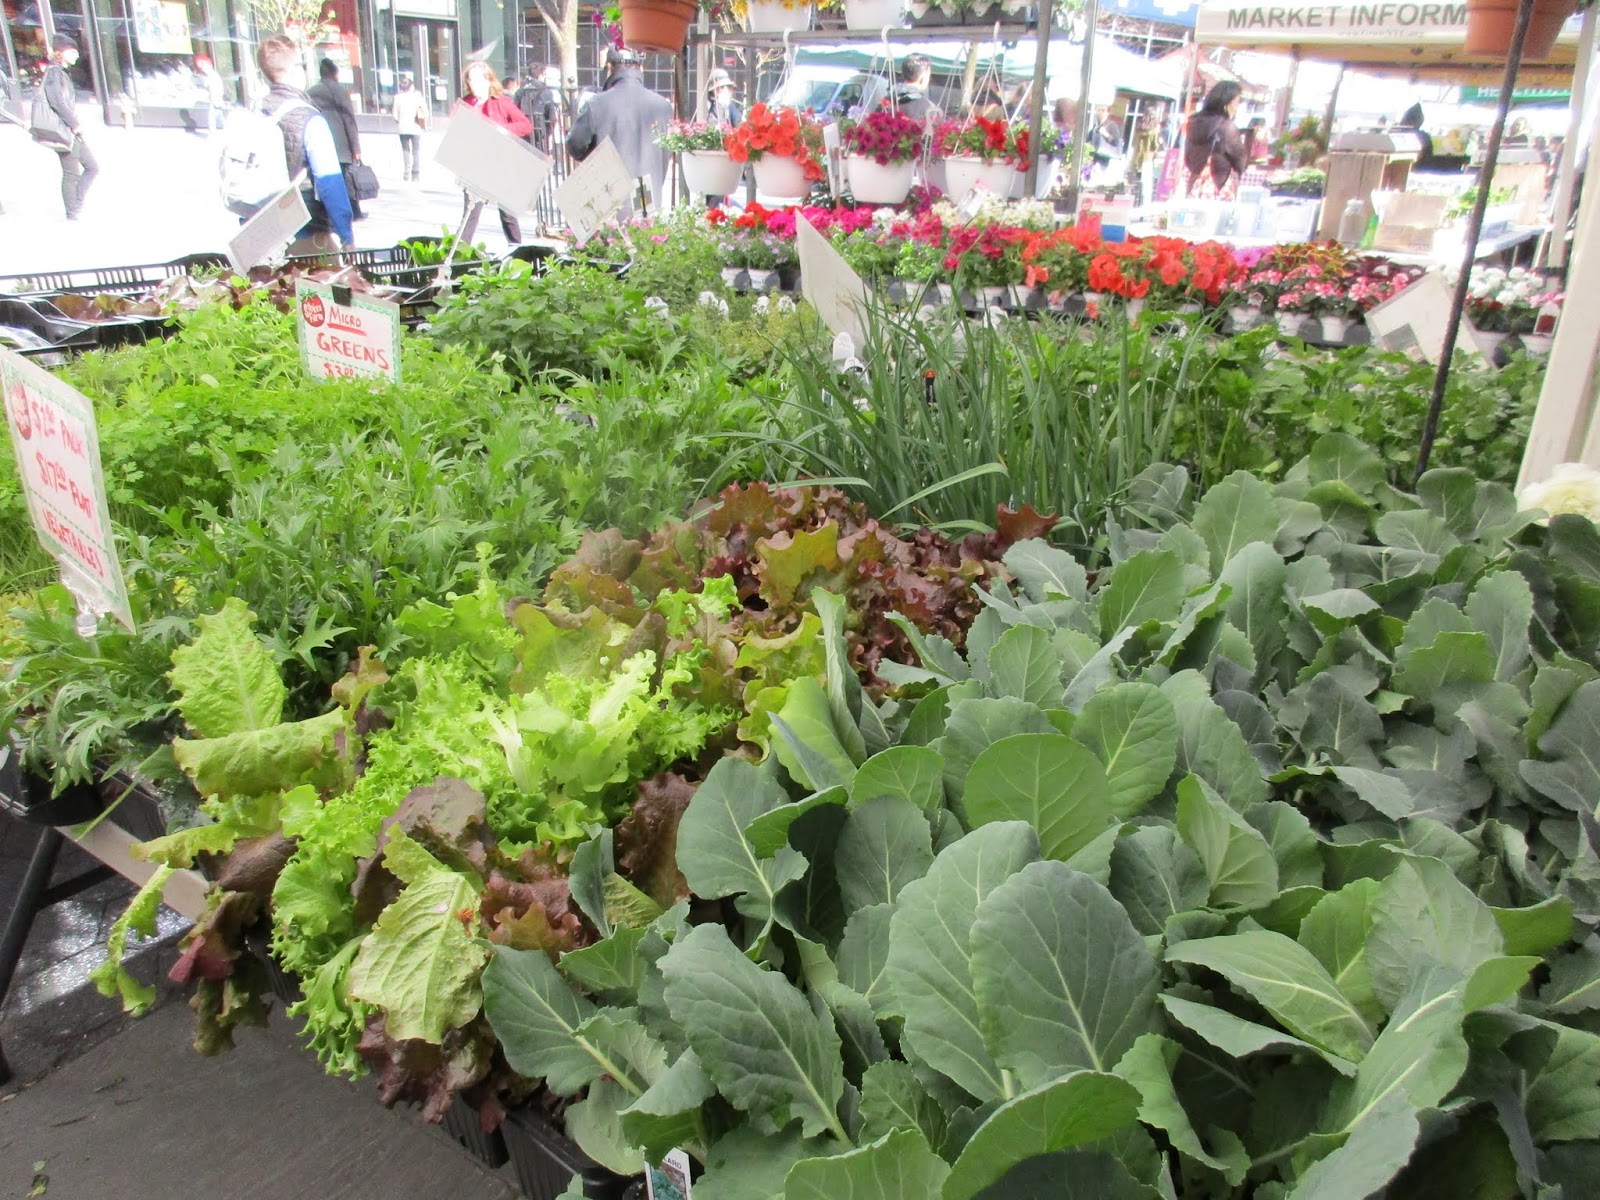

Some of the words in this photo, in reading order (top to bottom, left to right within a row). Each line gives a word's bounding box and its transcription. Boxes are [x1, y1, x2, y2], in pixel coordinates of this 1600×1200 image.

[1227, 7, 1342, 29] MARKET
[1348, 3, 1468, 27] INFORM
[329, 306, 362, 327] MICRO
[316, 332, 390, 370] GREENS
